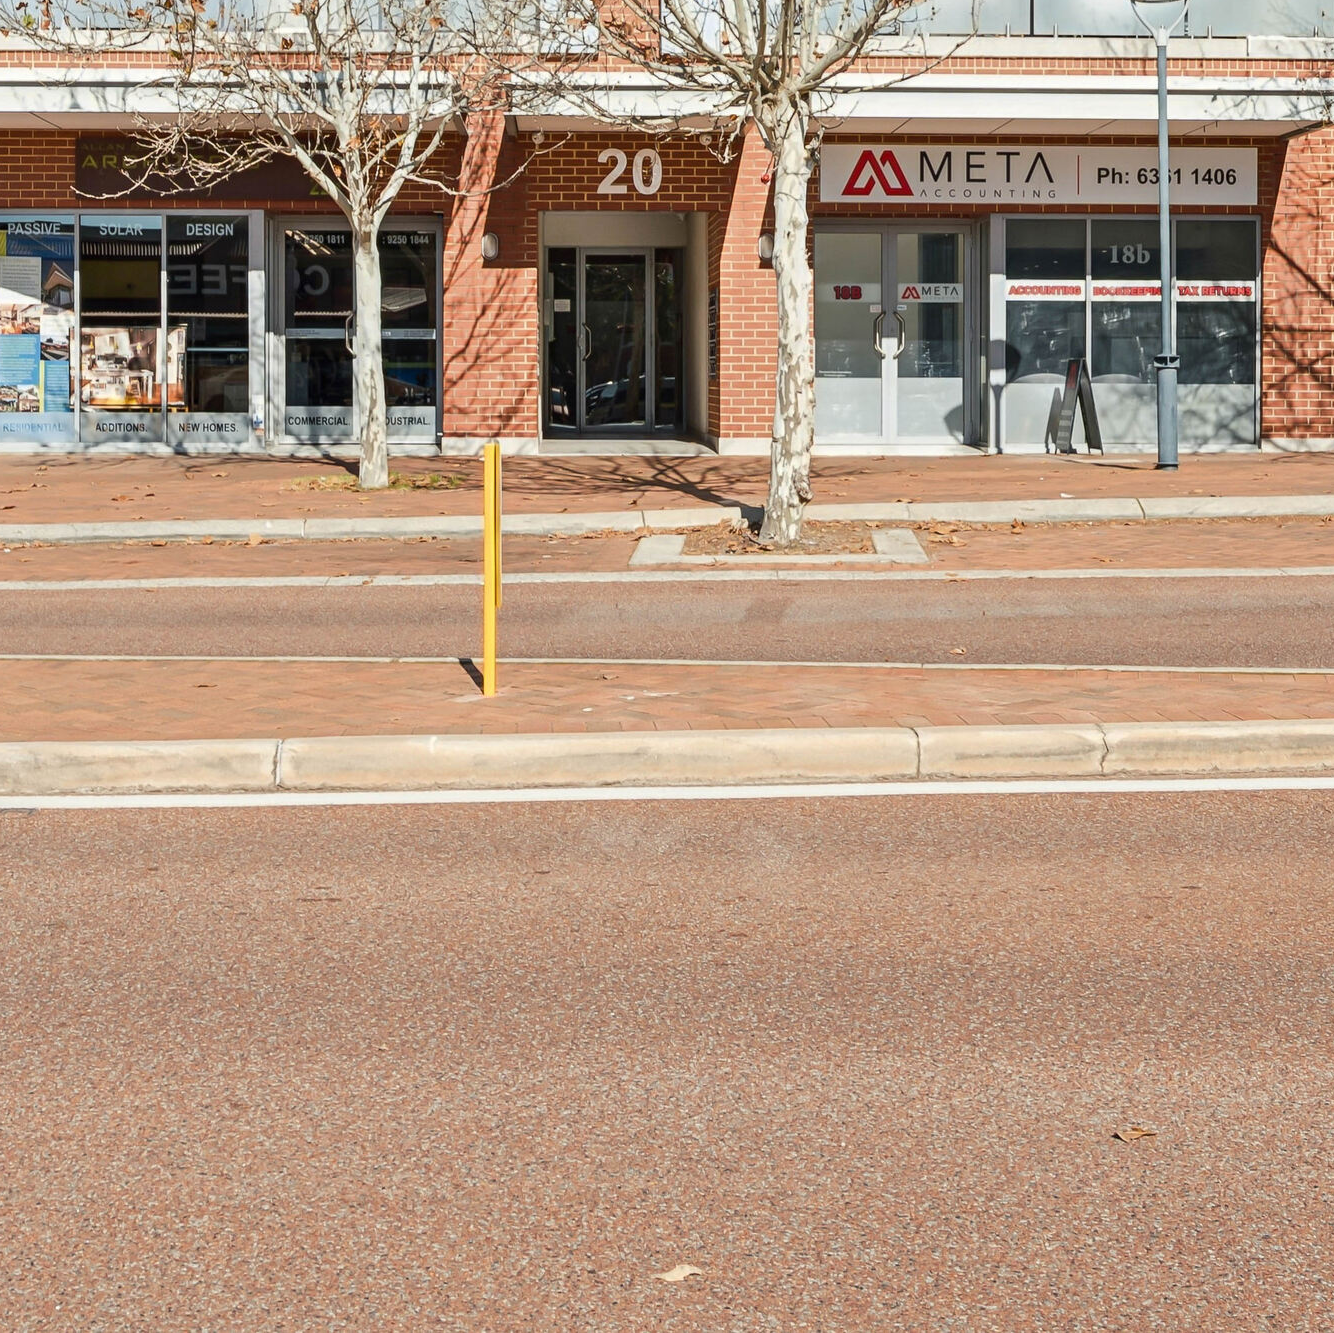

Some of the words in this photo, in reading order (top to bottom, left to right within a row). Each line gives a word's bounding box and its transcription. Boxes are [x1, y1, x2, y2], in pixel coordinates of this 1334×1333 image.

[596, 147, 663, 195] 20
[919, 151, 1054, 183] META
[1097, 168, 1129, 184] Ph:
[1191, 168, 1237, 185] 1406
[920, 189, 1056, 198] ACCOUNTING
[7, 223, 61, 235] PASSIVE
[99, 224, 143, 236] SOLAR
[186, 223, 234, 236] DESIGN
[326, 234, 346, 245] 1811
[387, 234, 408, 244] 9250
[410, 234, 430, 244] 1844
[1109, 243, 1151, 265] 18b
[921, 286, 959, 296] META
[1008, 284, 1082, 296] ACCOUNTING
[1092, 286, 1162, 297] BOOKKEEPIN
[1177, 285, 1200, 296] TAX
[1201, 285, 1253, 297] RETURNS
[288, 416, 351, 426] COMMERCIAL.
[385, 416, 431, 426] DUSTRIAL.
[95, 422, 148, 433] ADDITIONS.
[178, 423, 200, 433] NEW
[202, 422, 239, 433] HOMES.
